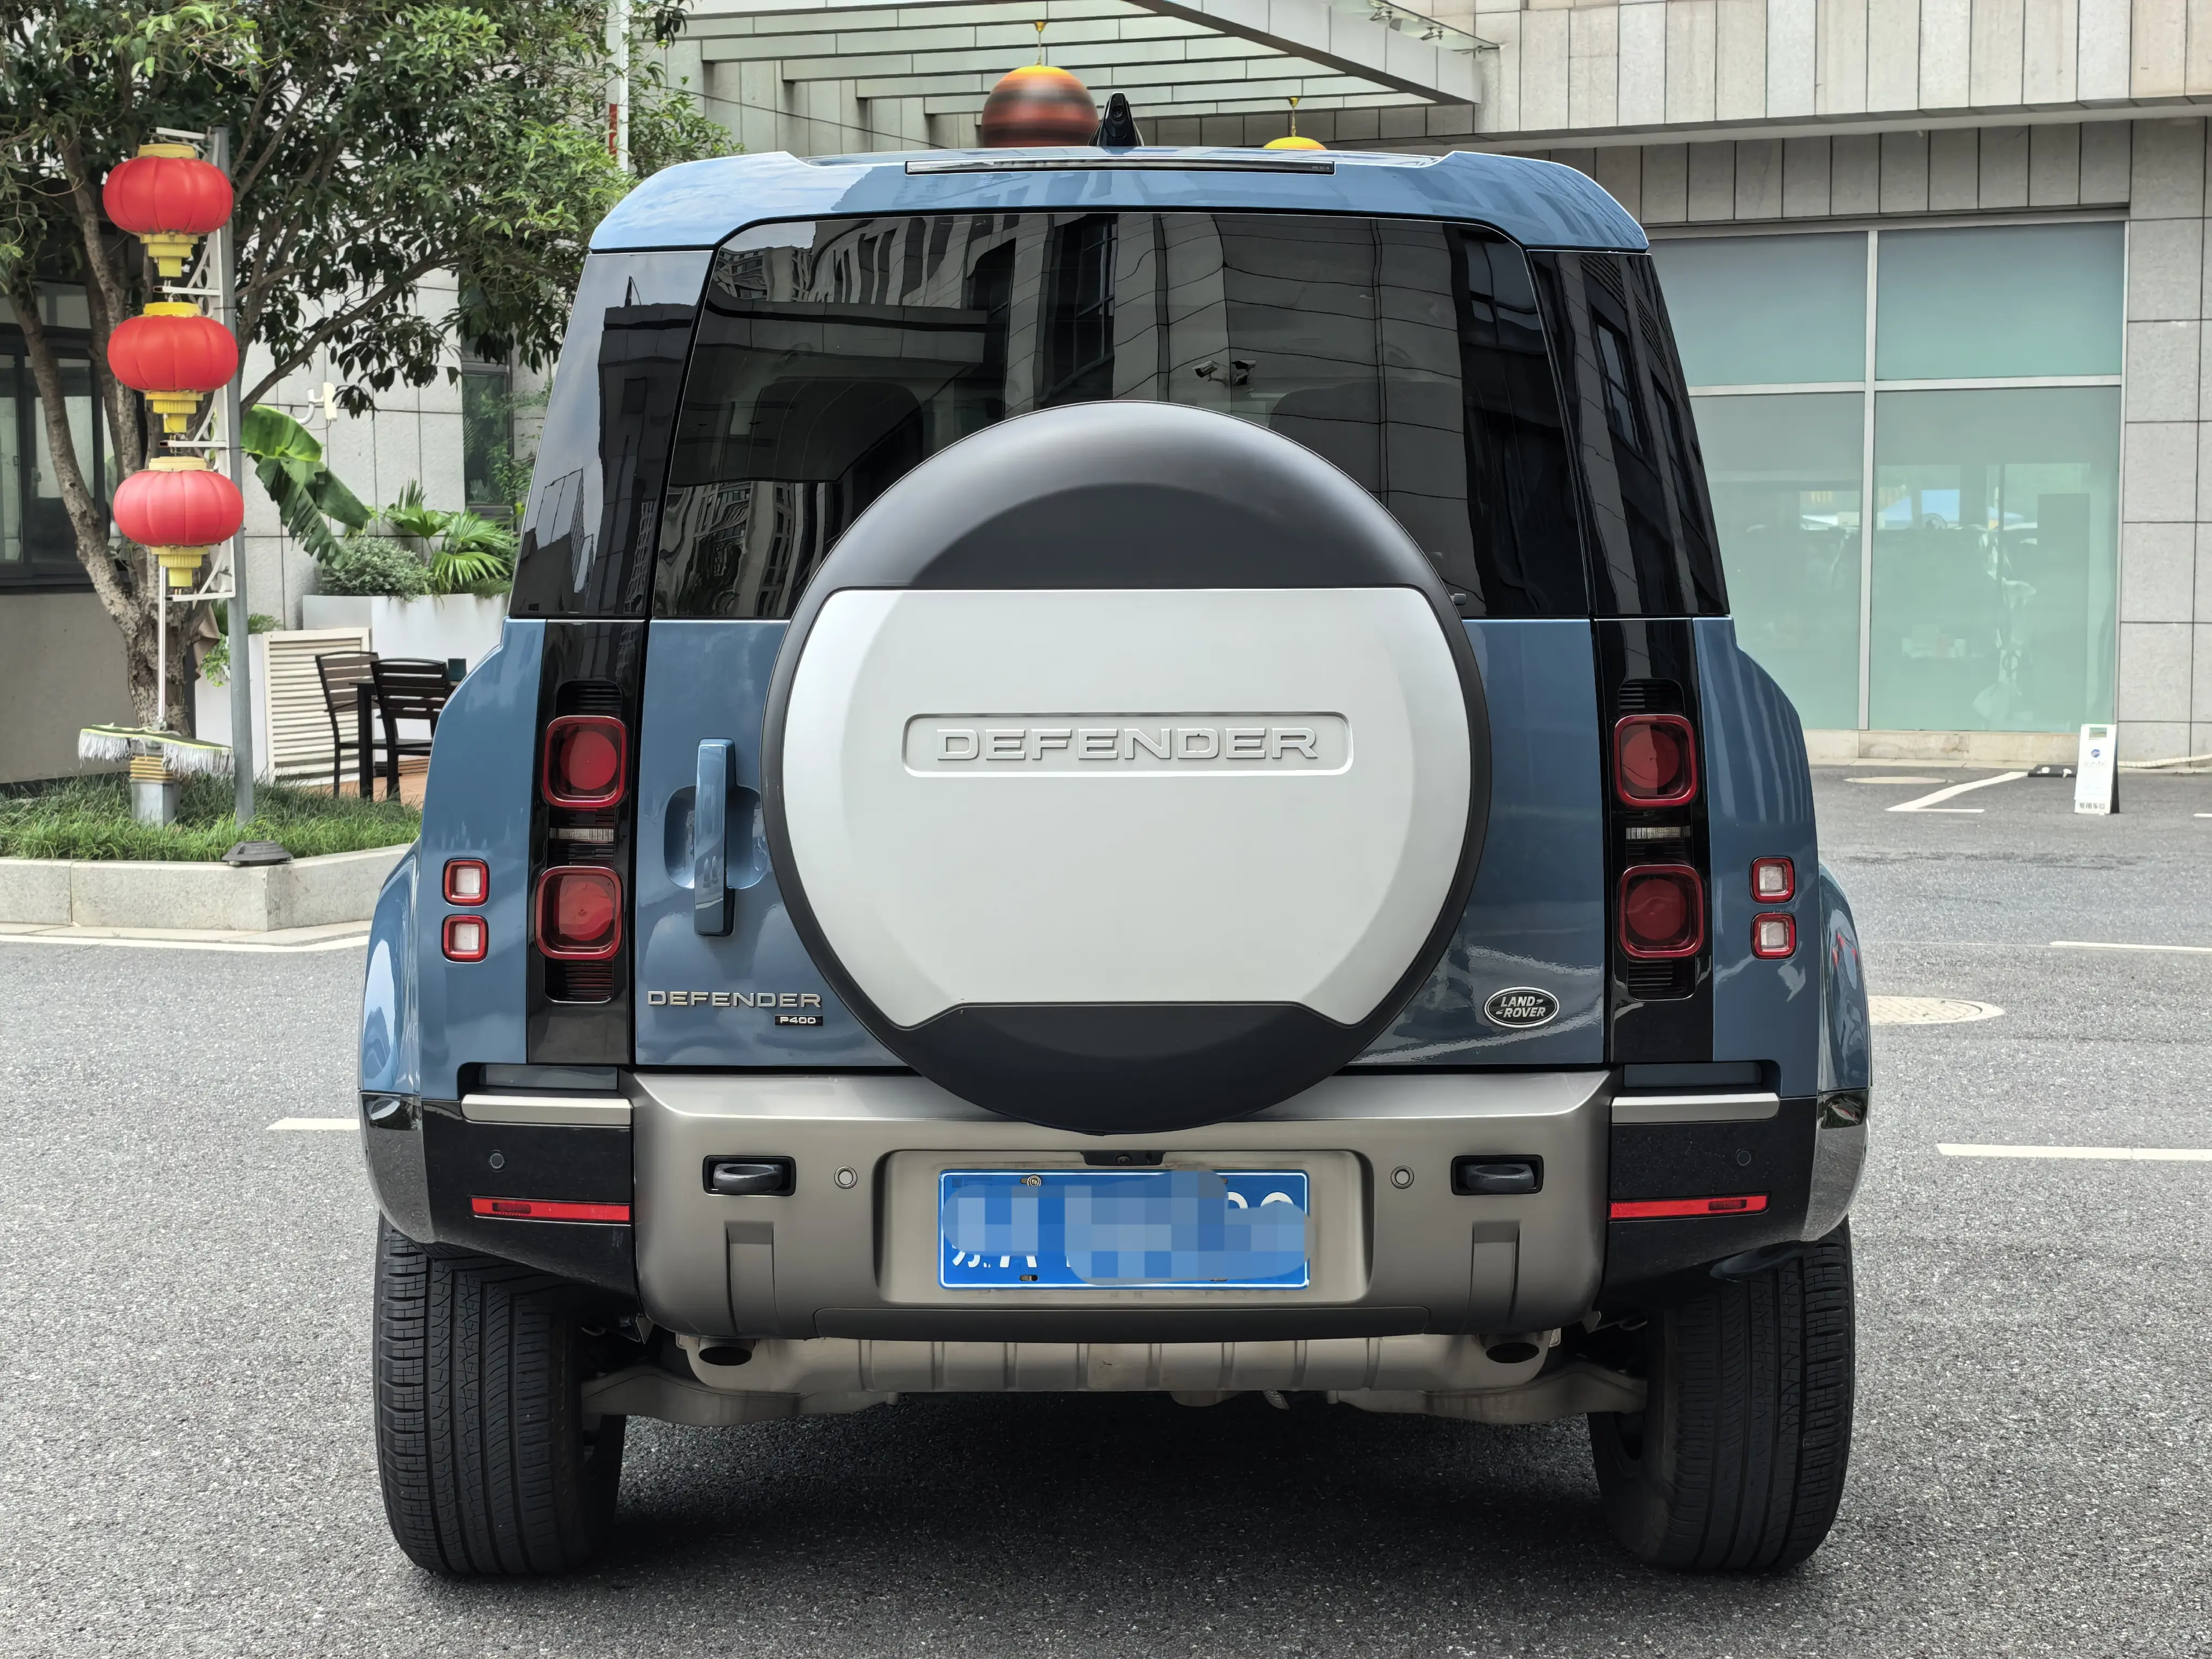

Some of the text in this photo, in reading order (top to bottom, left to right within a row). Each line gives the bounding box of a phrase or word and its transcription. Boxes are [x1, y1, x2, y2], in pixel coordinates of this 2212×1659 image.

[937, 728, 1319, 761] DEFENDER
[648, 991, 821, 1008] DEFENDER
[1501, 996, 1535, 1007] LAND
[1503, 1007, 1546, 1017] ROVER
[780, 1016, 817, 1024] P400
